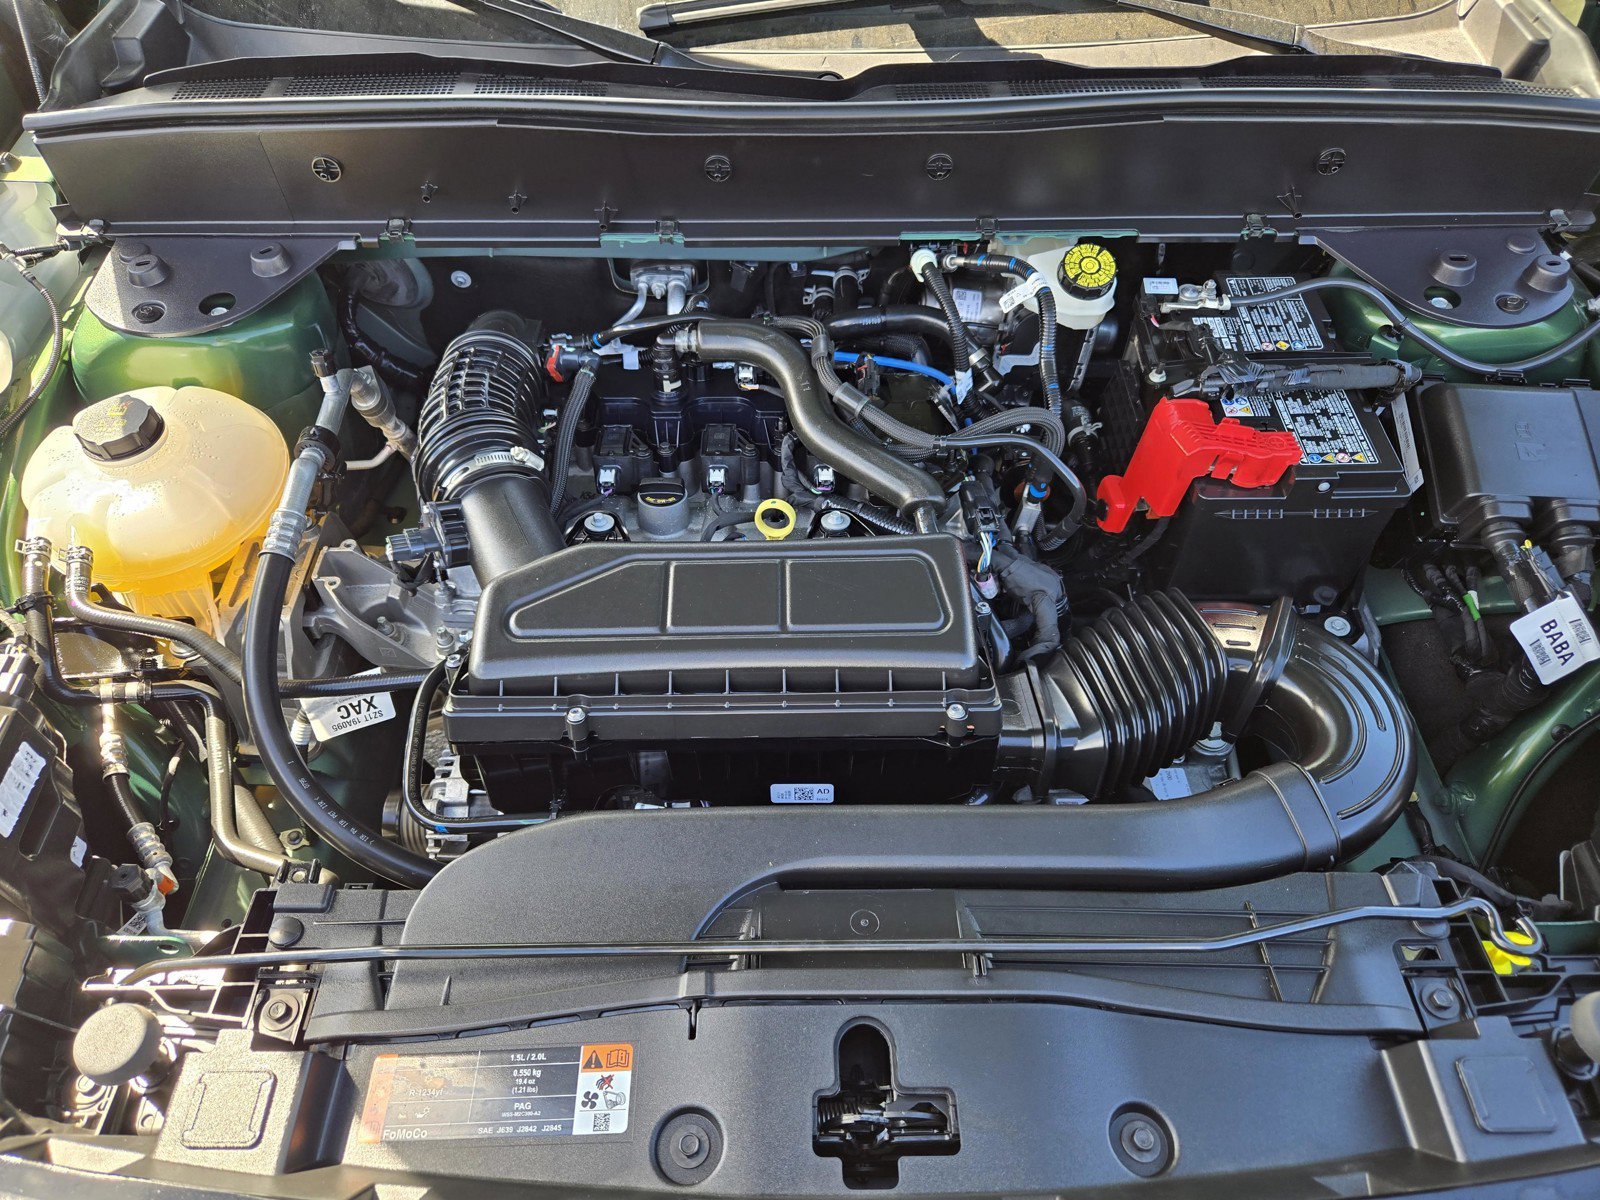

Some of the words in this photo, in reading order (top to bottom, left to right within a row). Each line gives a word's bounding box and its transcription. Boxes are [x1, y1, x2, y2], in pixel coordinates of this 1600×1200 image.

[1540, 619, 1575, 666] BABA
[337, 695, 378, 720] XAC
[331, 719, 361, 732] 19A095
[510, 1053, 525, 1061] 1.5L
[512, 1069, 531, 1077] 0.550
[532, 1068, 542, 1078] kg
[409, 1087, 443, 1098] R-1234yf
[514, 1102, 532, 1110] PAG
[382, 1127, 428, 1140] FoMoCo
[477, 1126, 494, 1135] SAE
[496, 1125, 513, 1134] J639
[516, 1124, 538, 1133] J2842
[541, 1124, 562, 1132] J2845
